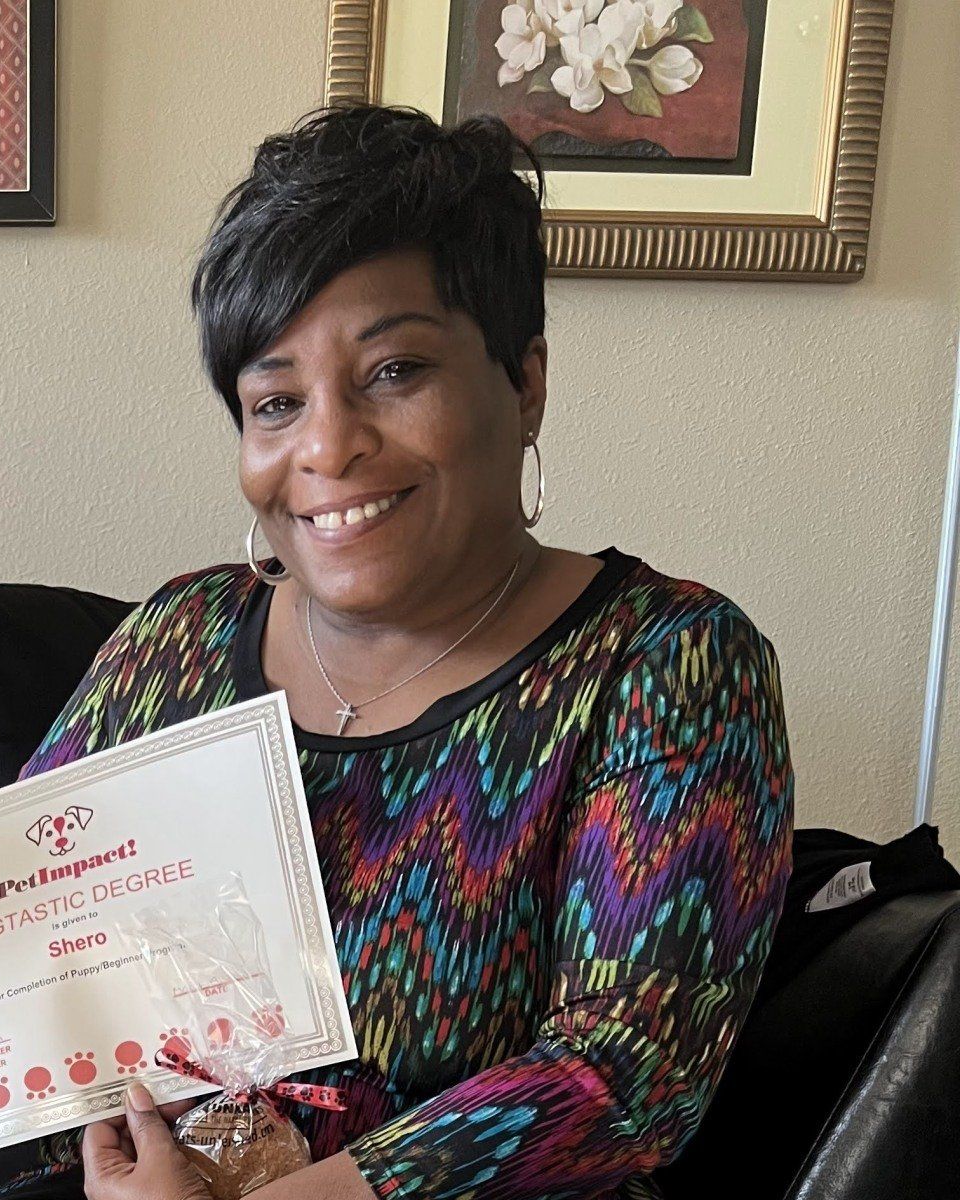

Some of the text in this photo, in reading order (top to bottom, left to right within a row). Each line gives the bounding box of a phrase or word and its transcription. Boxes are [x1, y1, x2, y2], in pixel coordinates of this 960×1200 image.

[92, 859, 195, 903] DEGREE
[52, 911, 98, 930] is given to
[48, 932, 107, 958] Shero
[6, 975, 57, 998] Completion
[59, 971, 69, 981] of
[71, 953, 144, 979] Puppy/Beginner
